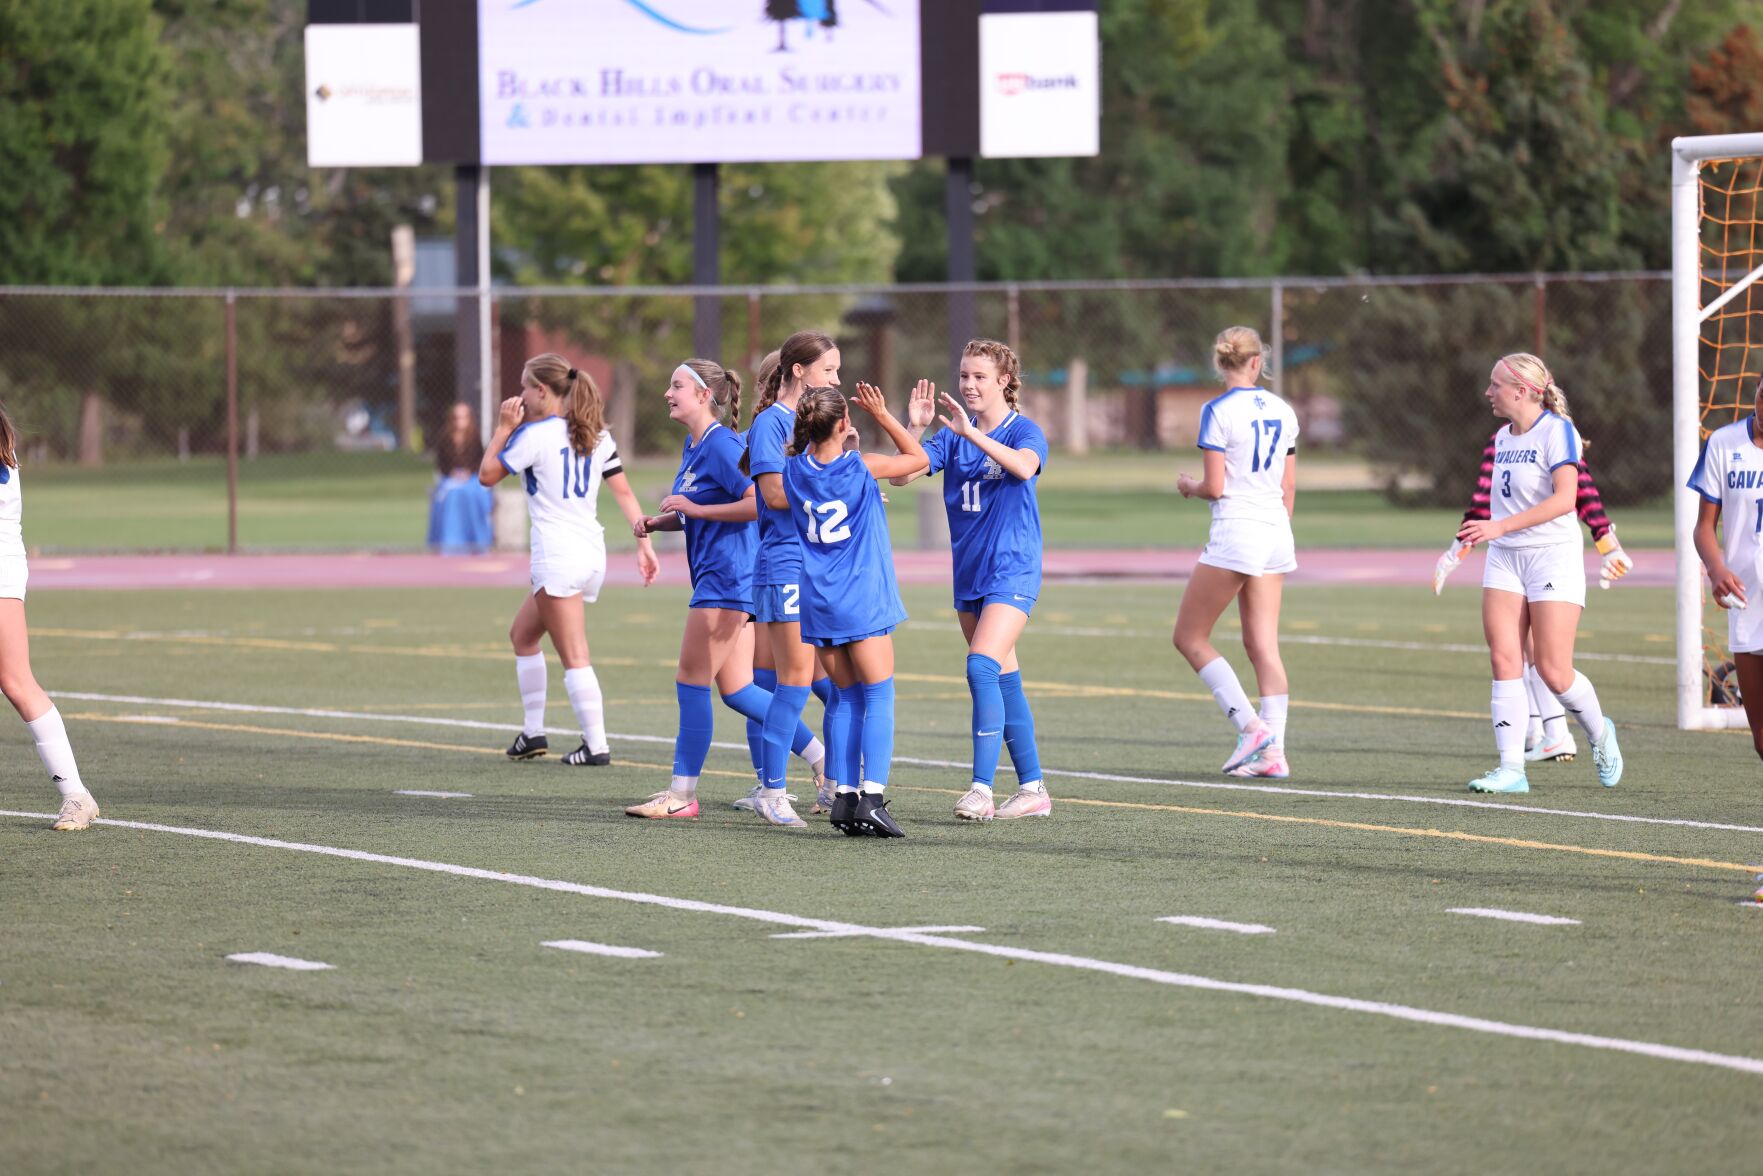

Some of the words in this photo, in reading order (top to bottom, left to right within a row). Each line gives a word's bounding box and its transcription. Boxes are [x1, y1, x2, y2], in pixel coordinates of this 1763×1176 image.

[505, 102, 531, 128] &
[541, 107, 639, 127] Dental
[655, 104, 772, 129] Implant
[787, 102, 889, 123] Center
[1251, 419, 1282, 472] 17
[1496, 449, 1538, 464] AVALIERS
[560, 447, 592, 499] 10
[1501, 469, 1512, 497] 3
[962, 481, 981, 511] 11
[803, 499, 851, 544] 12
[783, 583, 800, 615] 2
